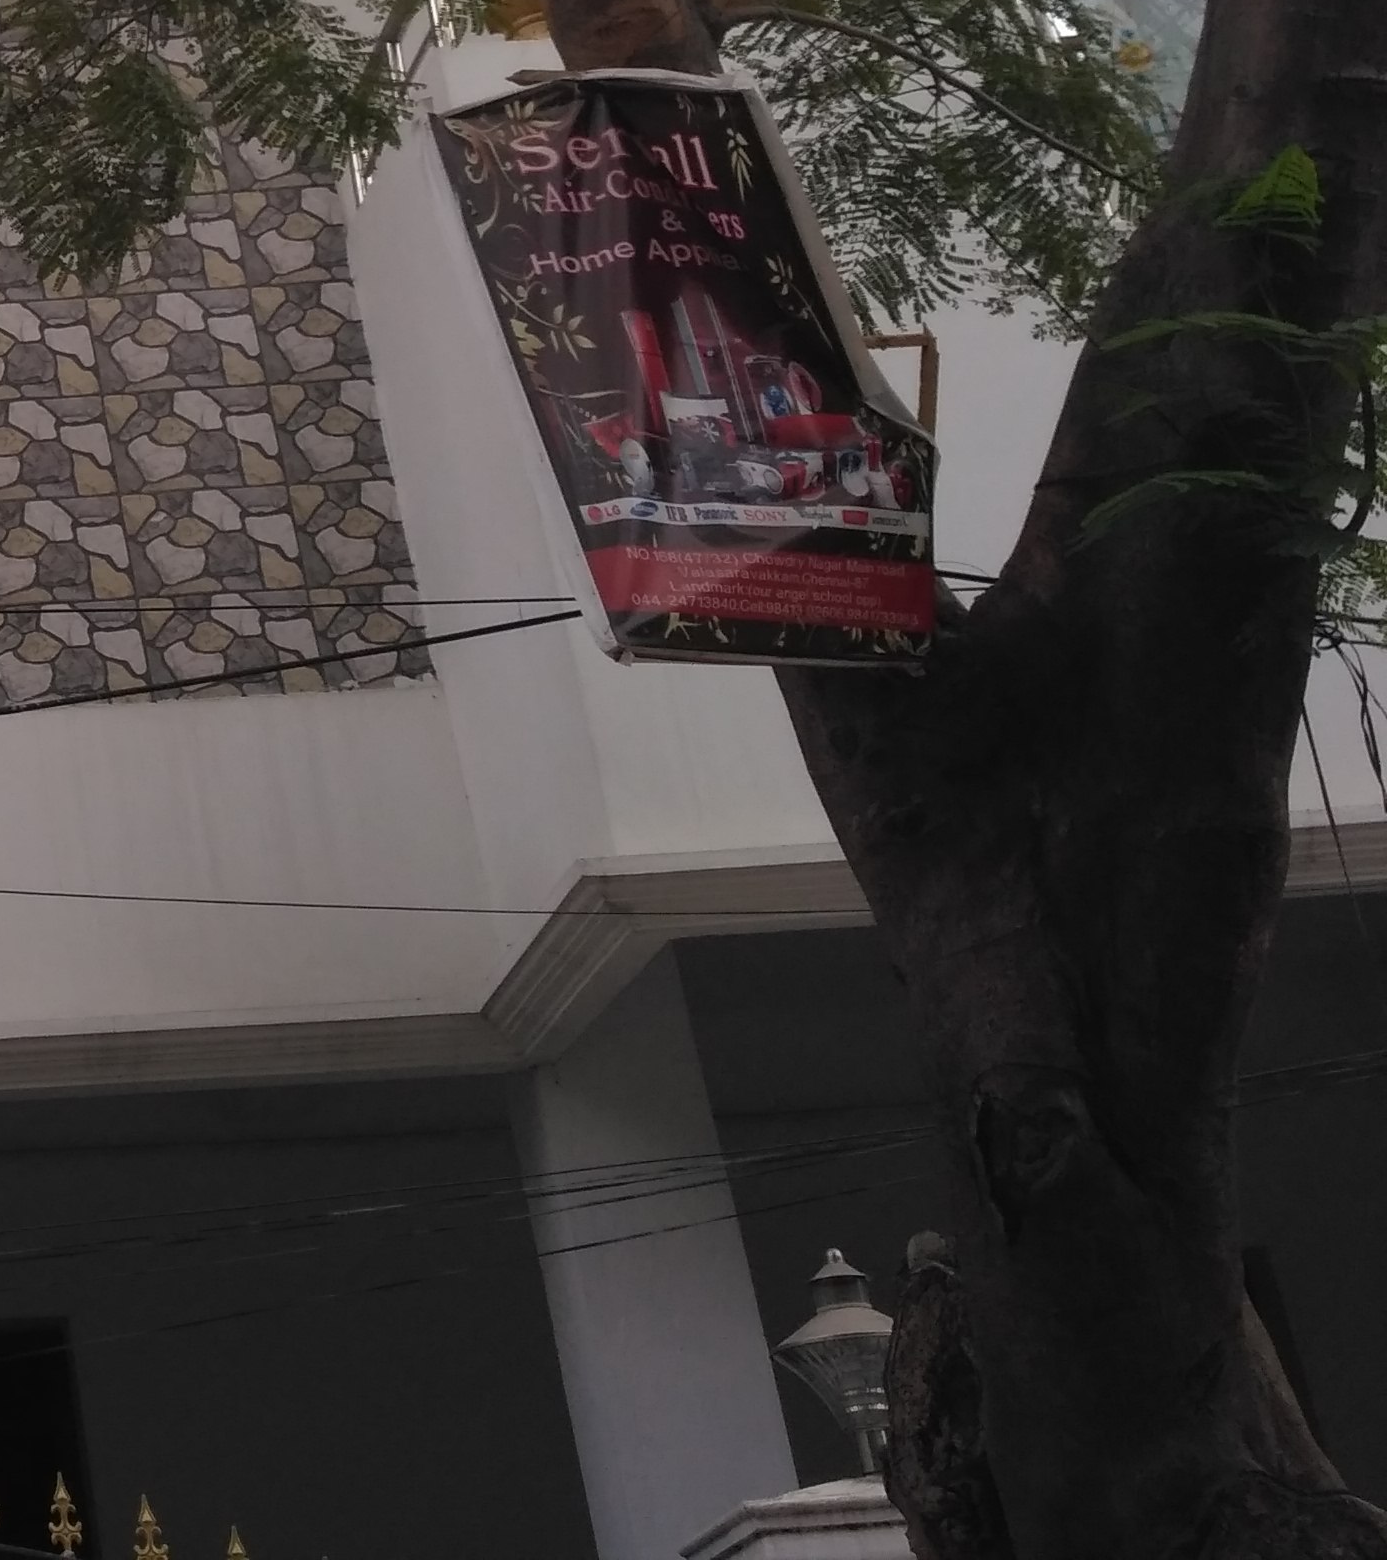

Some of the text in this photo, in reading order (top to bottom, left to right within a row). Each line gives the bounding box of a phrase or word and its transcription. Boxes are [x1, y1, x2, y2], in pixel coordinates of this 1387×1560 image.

[661, 209, 686, 232] &
[529, 241, 635, 275] Home
[603, 505, 621, 517] LG
[743, 509, 788, 523] SONY
[809, 557, 842, 573] Nagar
[813, 591, 852, 605] school
